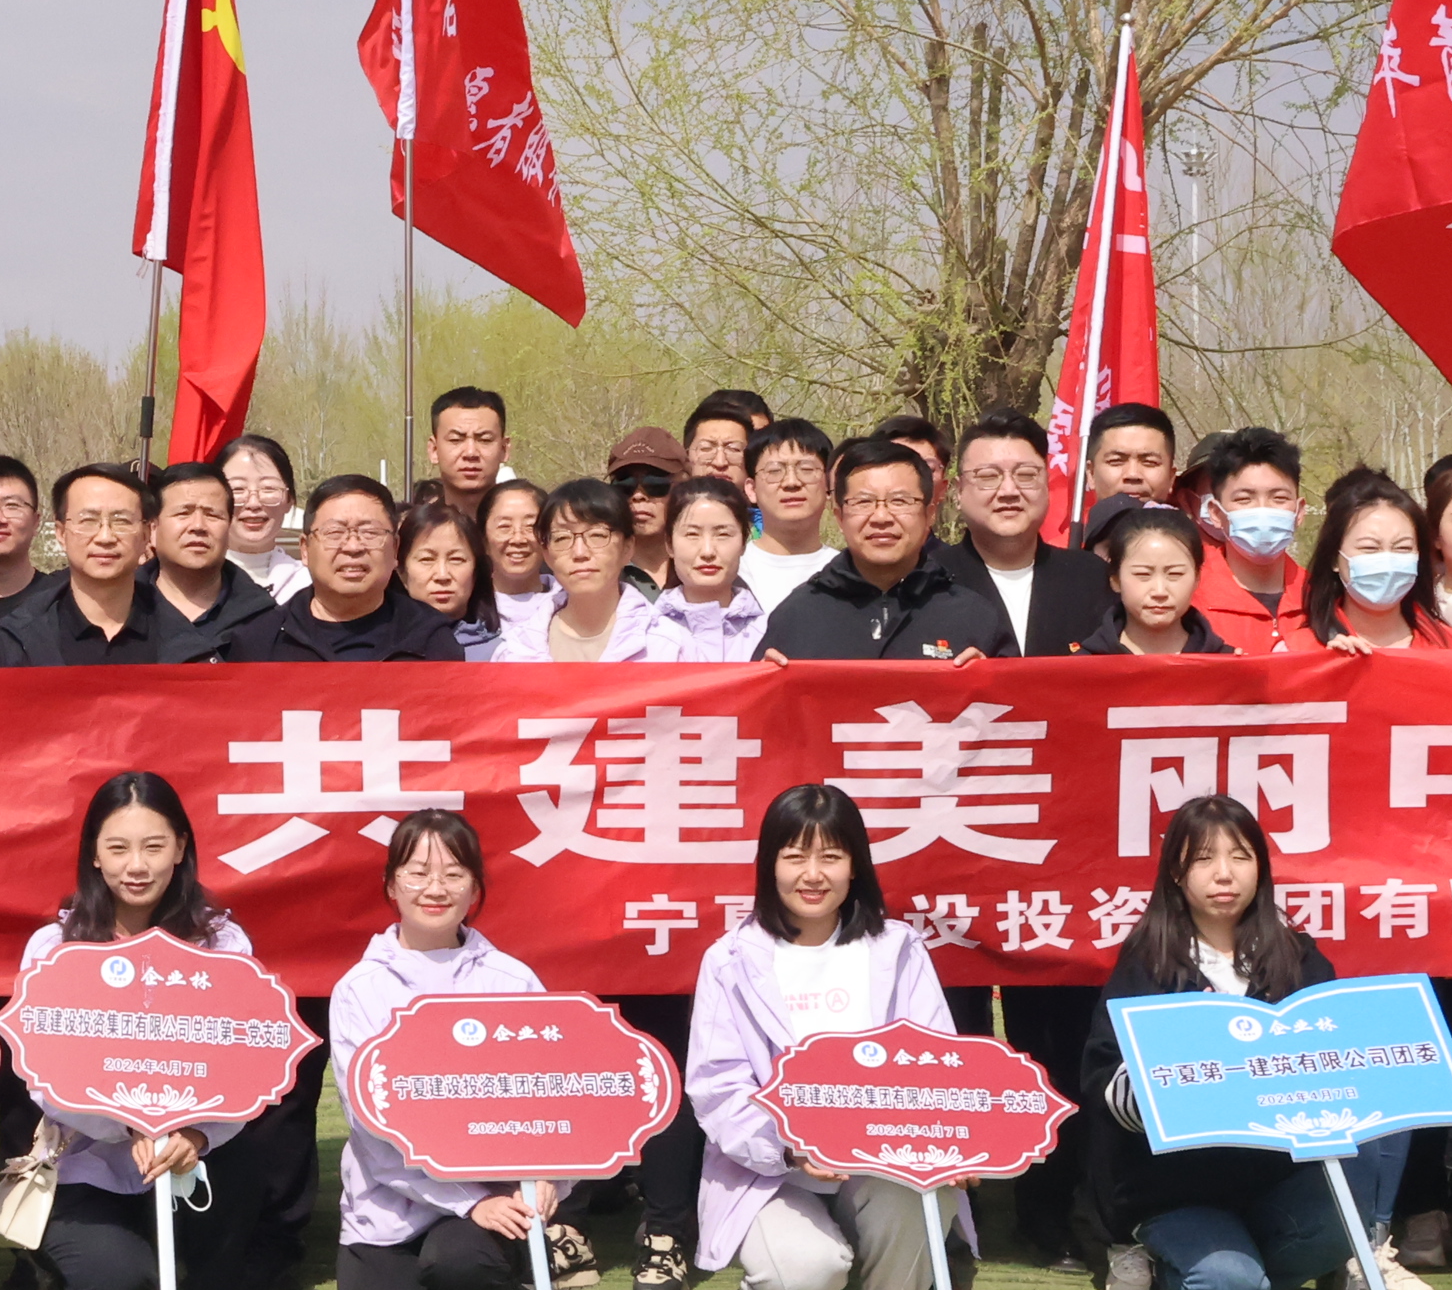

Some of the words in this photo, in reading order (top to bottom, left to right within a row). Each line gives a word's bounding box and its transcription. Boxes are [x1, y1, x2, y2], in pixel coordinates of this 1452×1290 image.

[141, 967, 213, 991] 企业林
[20, 1006, 290, 1049] 宁夏建设投资集团有限公司总部第二党支部
[492, 1024, 564, 1041] 企业林
[1268, 1016, 1339, 1036] 企业林
[104, 1058, 207, 1077] 2024年4月7日
[893, 1049, 964, 1067] 企业林
[1151, 1042, 1439, 1088] 宁夏第一建筑有限公司团委
[392, 1072, 635, 1101] 宁夏建设投资集团有限公司党委
[1257, 1086, 1358, 1107] 2024年4月7日
[779, 1084, 1047, 1114] 宁夏建设投资集团有限公司总部第一党支部
[468, 1120, 571, 1135] 2024年4月7日
[866, 1123, 969, 1139] 2024年4月7日
